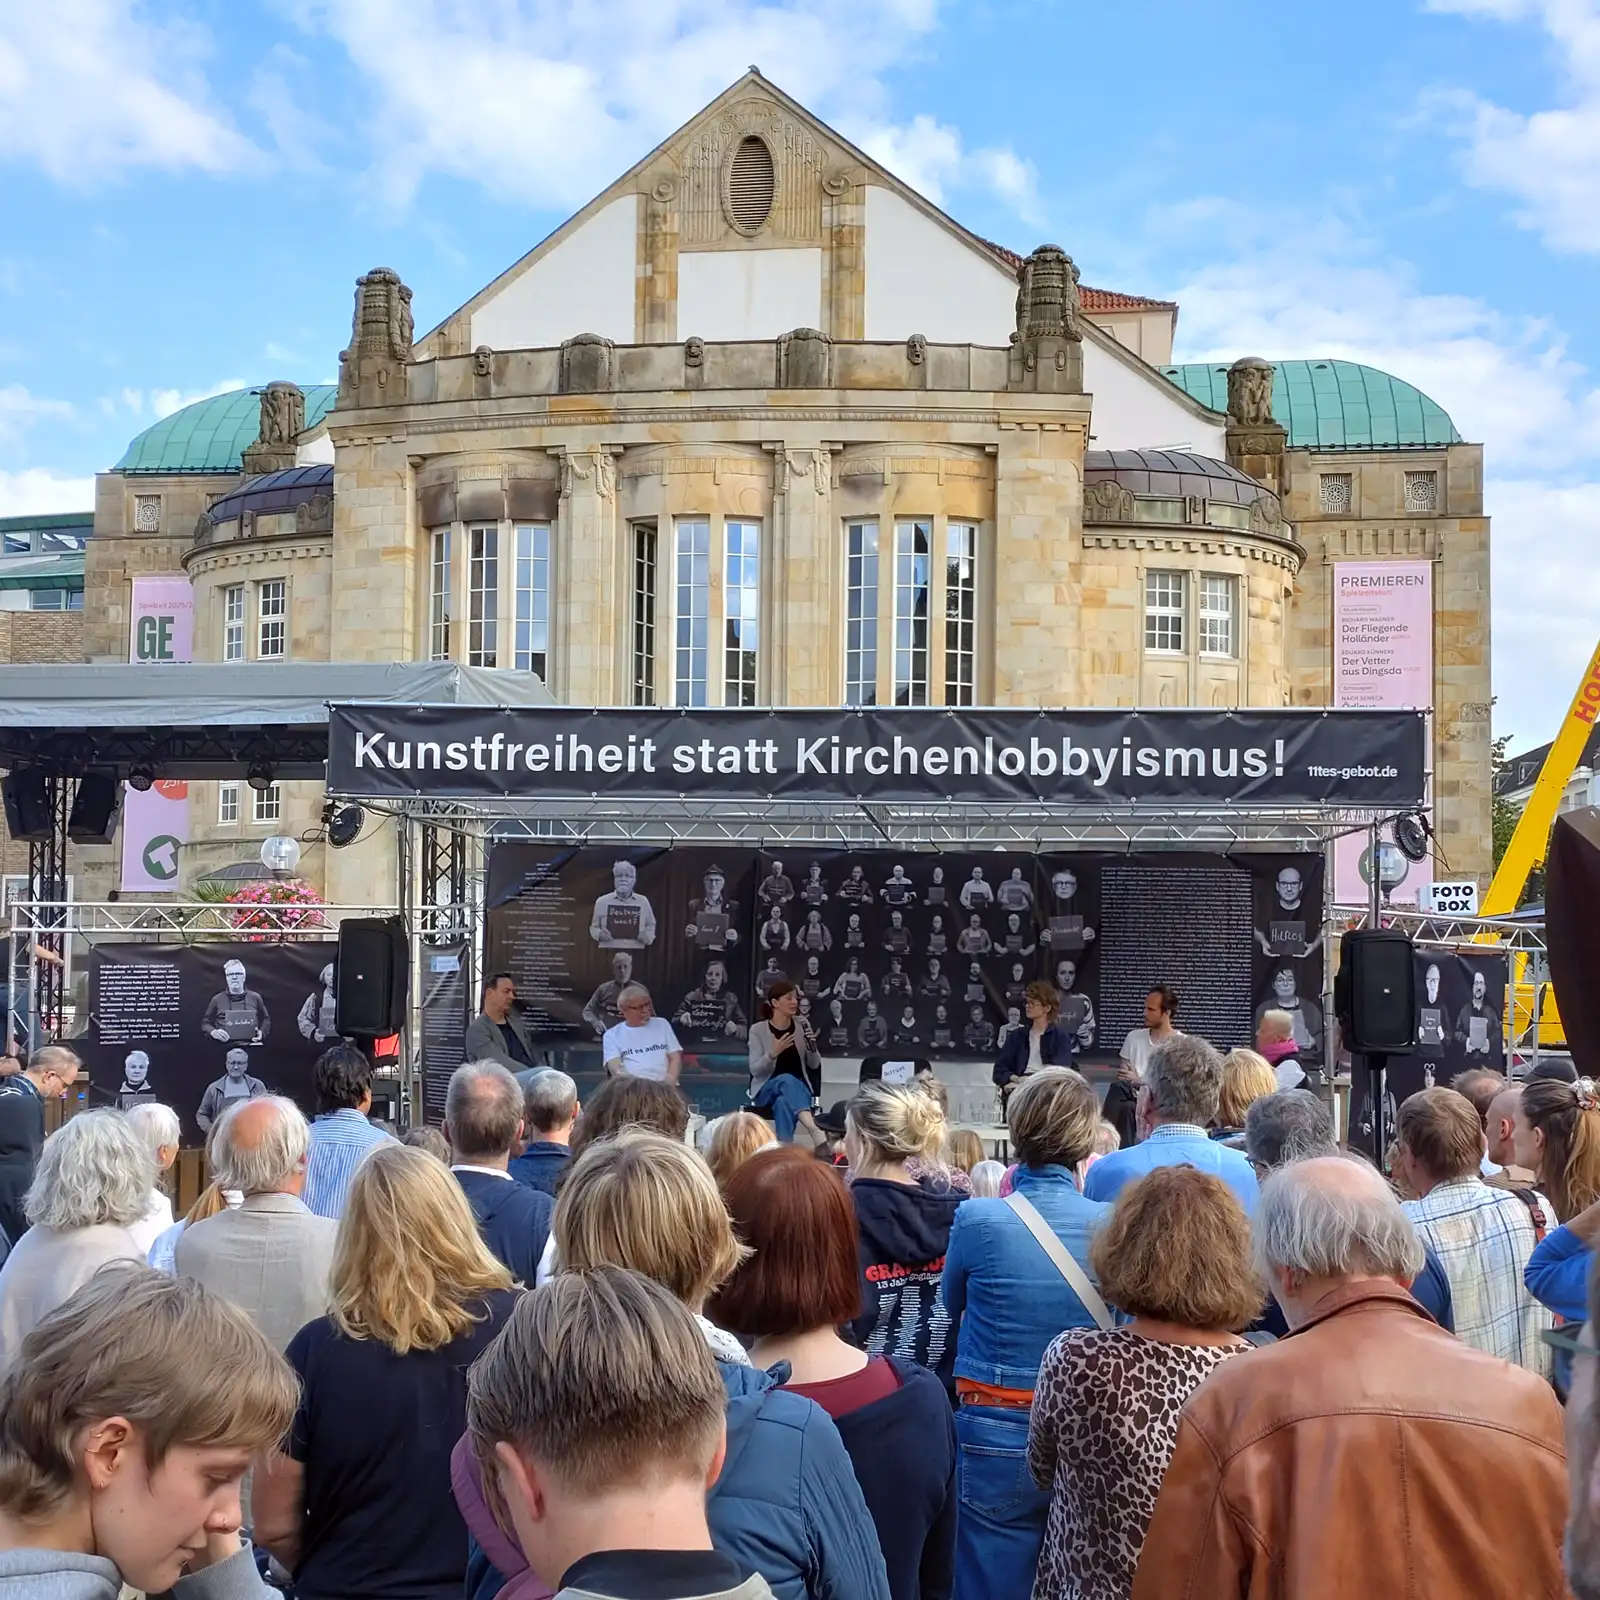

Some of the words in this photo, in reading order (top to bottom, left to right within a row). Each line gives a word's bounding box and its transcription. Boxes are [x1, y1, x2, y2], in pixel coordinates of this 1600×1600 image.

[1341, 575, 1424, 587] PREMIEREN
[1341, 624, 1359, 633] Der
[1361, 623, 1409, 634] Fliegende
[136, 615, 175, 659] GE
[1341, 633, 1390, 643] Holländer
[1341, 657, 1360, 666] Der
[1360, 656, 1390, 665] Vetter
[1341, 668, 1360, 676] aus
[1361, 666, 1402, 677] Dingsda
[355, 731, 656, 773] Kunstfreiheit
[672, 738, 778, 775] statt
[796, 735, 1284, 786] Kirchenlobbyismus!
[1307, 764, 1398, 780] 11tes-gebot.de
[1432, 885, 1474, 898] FOTO
[1437, 900, 1471, 912] BOX
